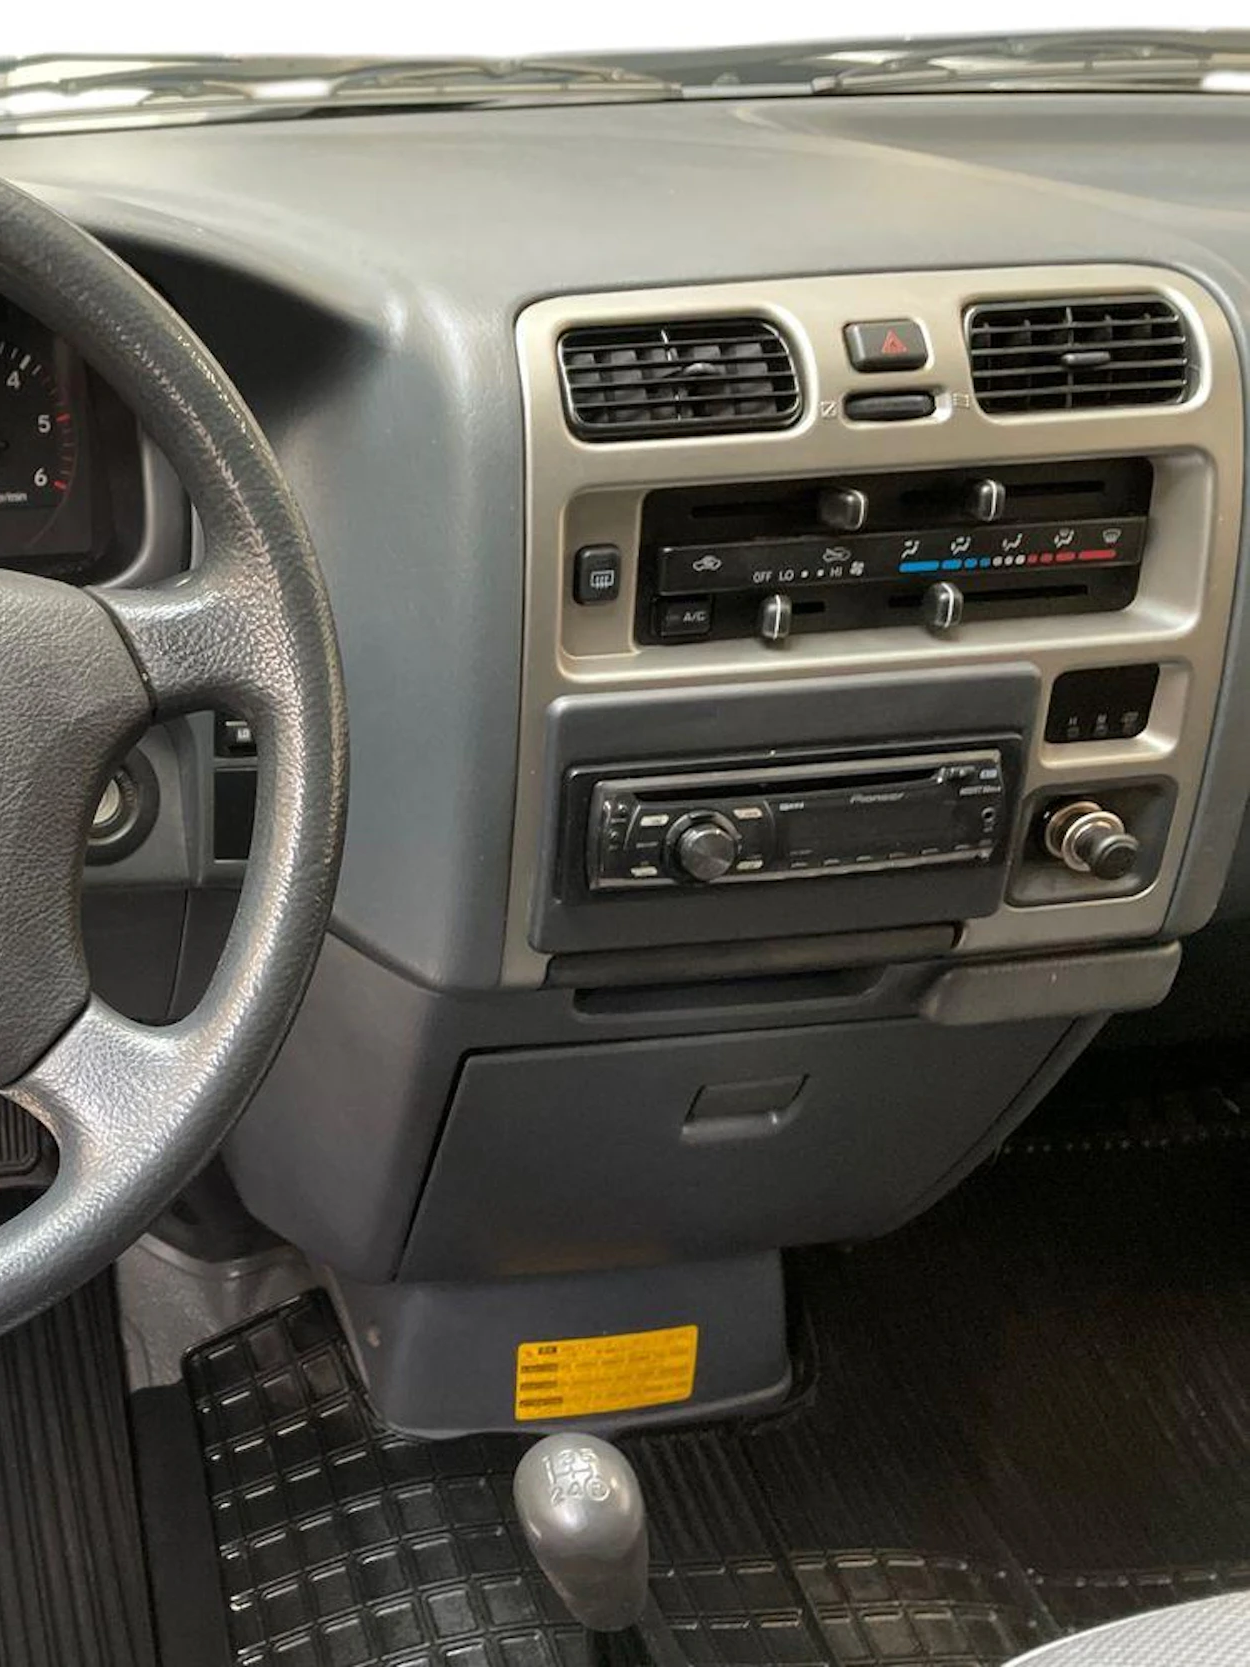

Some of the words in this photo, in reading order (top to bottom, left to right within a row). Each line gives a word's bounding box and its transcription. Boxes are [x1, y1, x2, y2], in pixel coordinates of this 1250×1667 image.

[6, 371, 20, 389] 4
[37, 414, 51, 433] 5
[34, 467, 48, 487] 6
[753, 571, 772, 583] OFF
[778, 569, 795, 582] LO
[830, 566, 843, 578] HI
[683, 611, 706, 622] A/C
